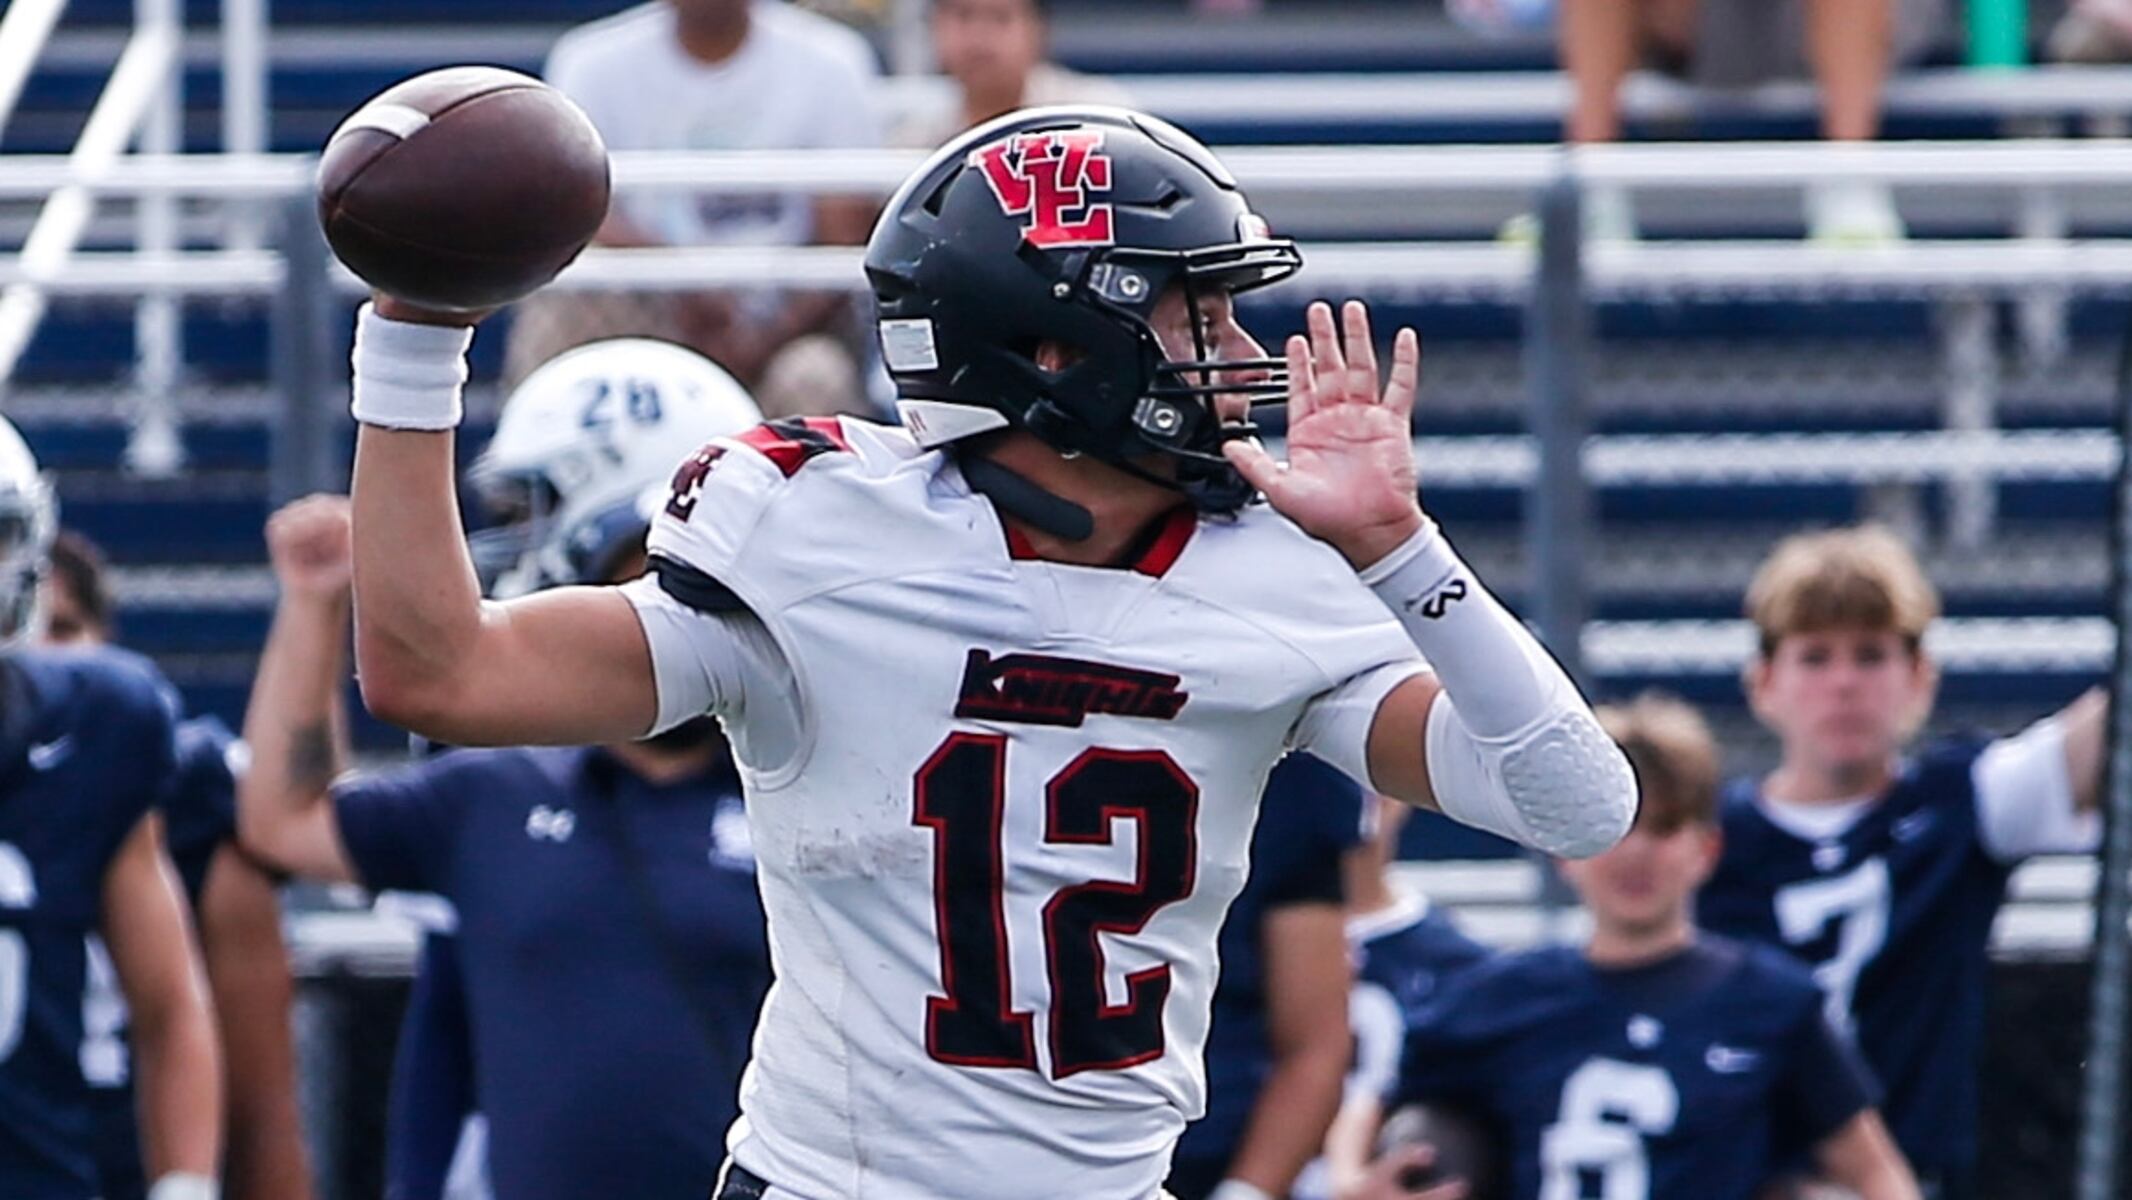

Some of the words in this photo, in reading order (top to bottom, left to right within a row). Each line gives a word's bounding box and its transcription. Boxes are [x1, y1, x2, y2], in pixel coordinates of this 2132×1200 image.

[967, 131, 1115, 249] WE
[911, 730, 1200, 1080] 12
[1772, 857, 1892, 1042] 7
[1538, 1055, 1681, 1200] 6
